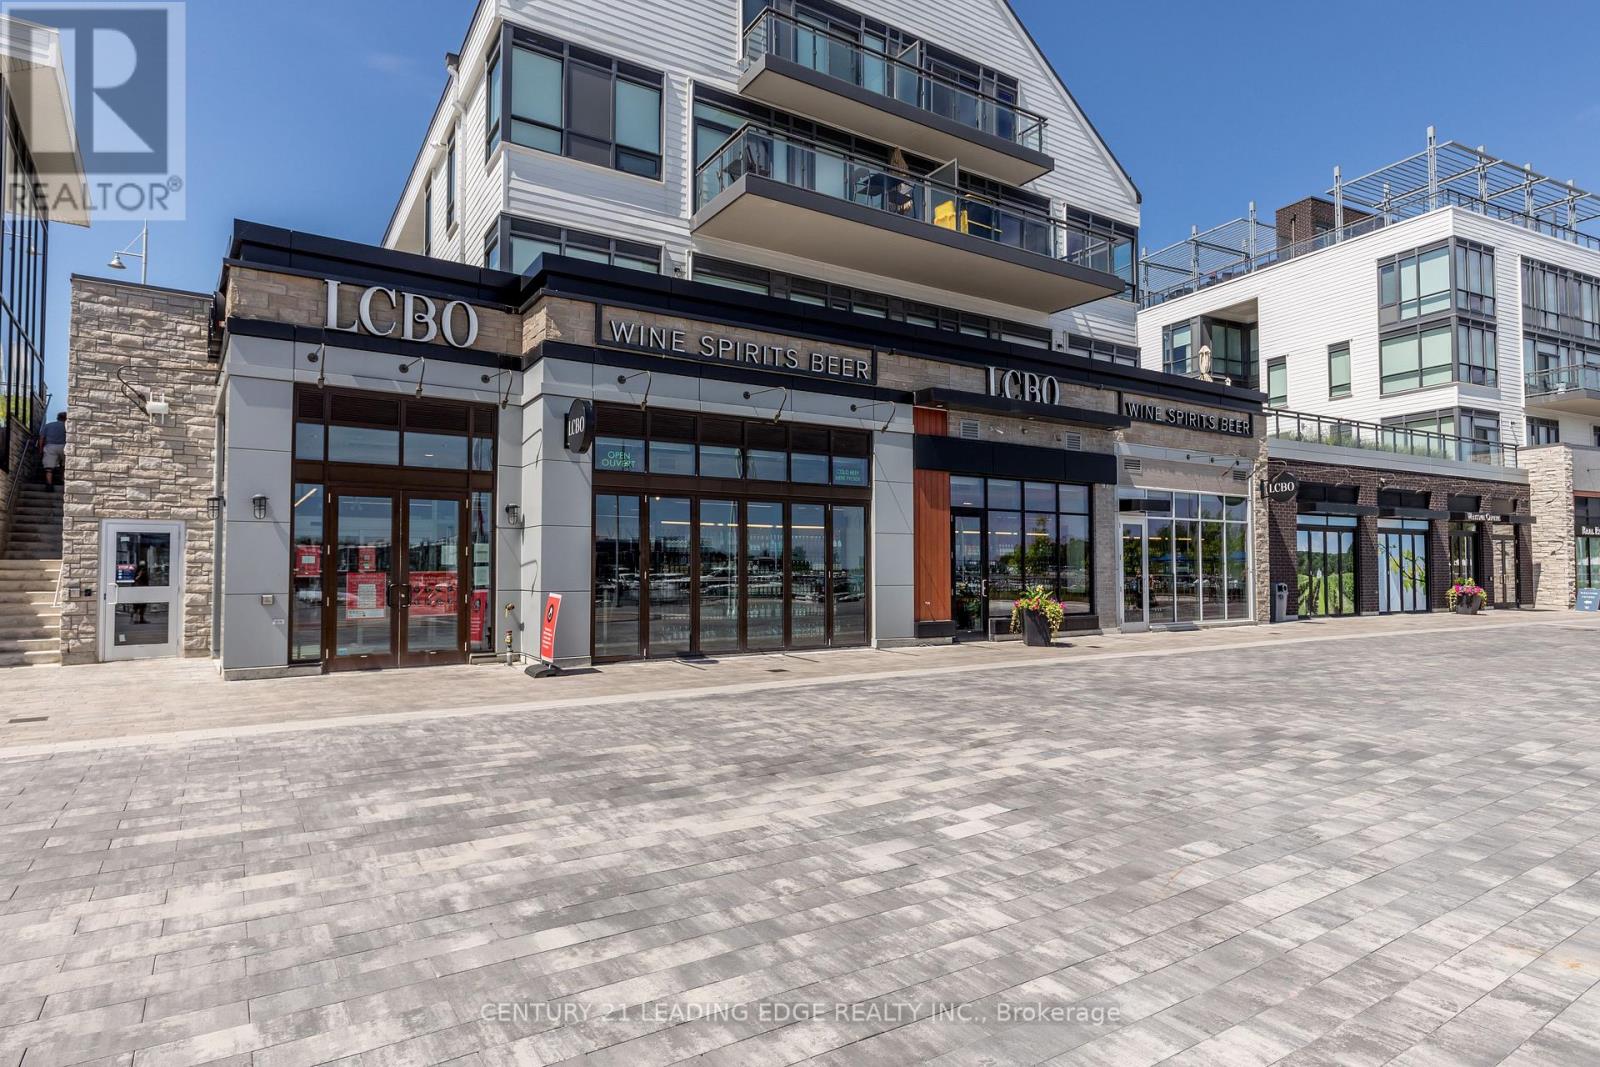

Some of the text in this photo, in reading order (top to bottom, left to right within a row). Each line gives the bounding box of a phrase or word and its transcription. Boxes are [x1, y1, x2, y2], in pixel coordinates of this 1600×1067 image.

[324, 279, 479, 348] LCBO
[610, 319, 869, 380] WINE SPIRITS BEER
[568, 415, 585, 436] LCBO
[1127, 402, 1250, 435] WINE SPIRITS BEER
[607, 451, 631, 460] OPEN
[1269, 481, 1295, 493] LCBO
